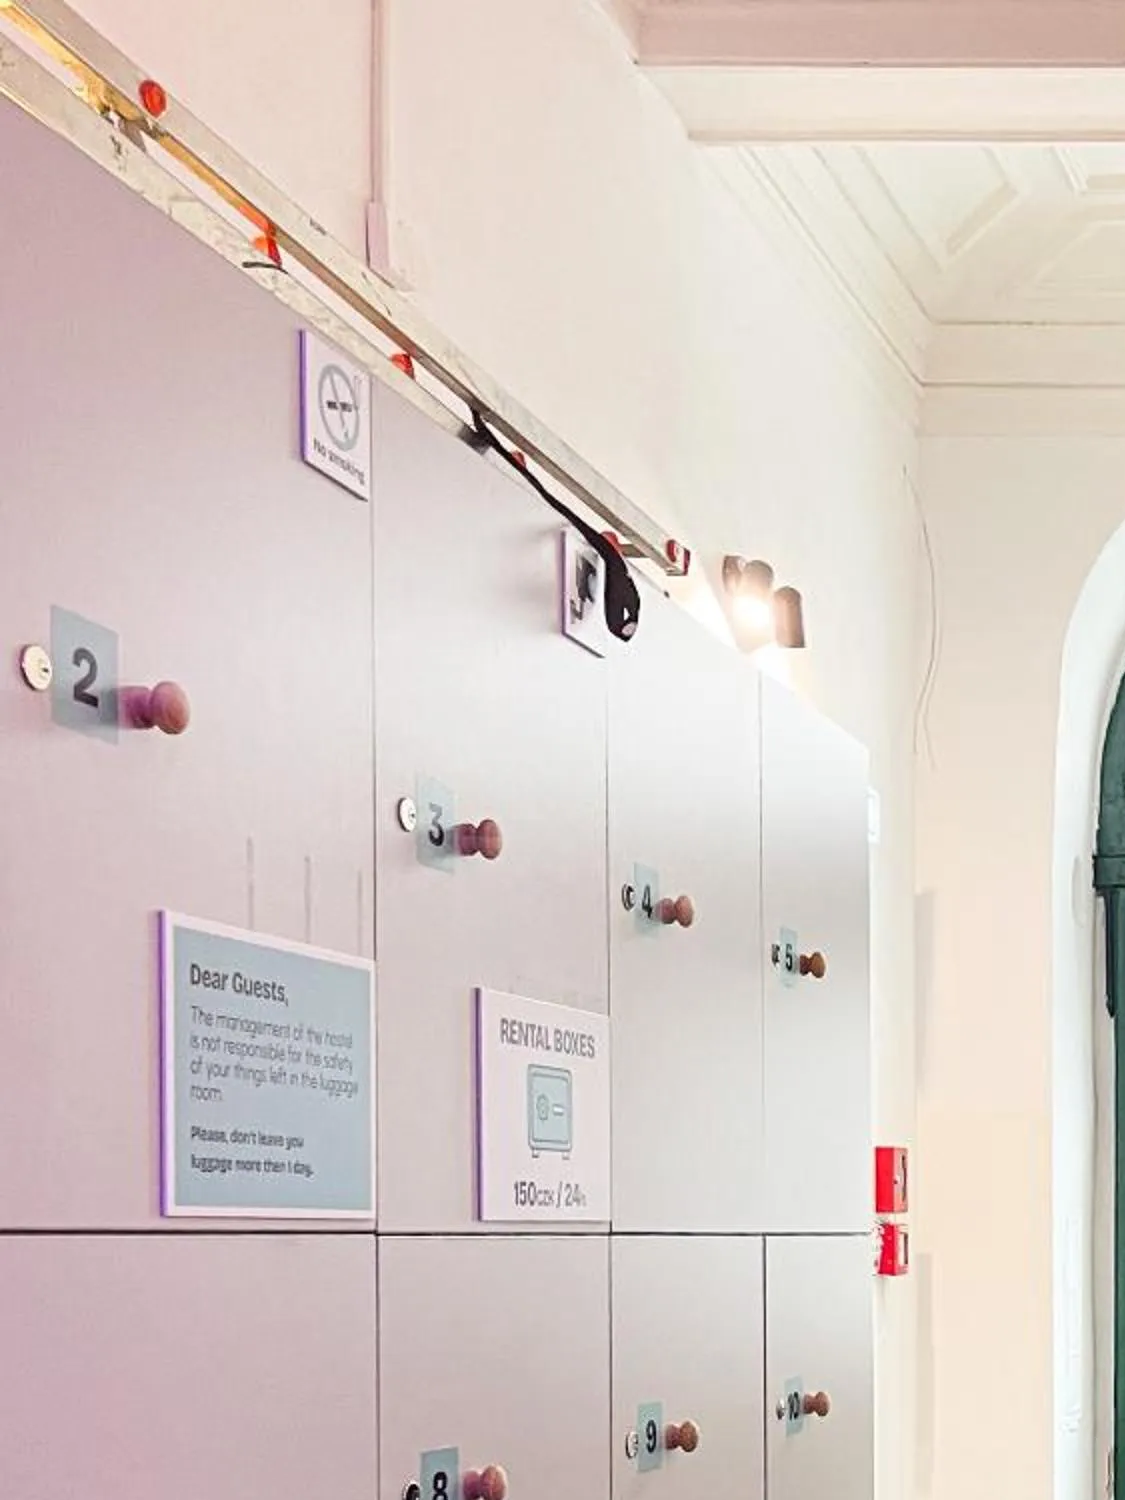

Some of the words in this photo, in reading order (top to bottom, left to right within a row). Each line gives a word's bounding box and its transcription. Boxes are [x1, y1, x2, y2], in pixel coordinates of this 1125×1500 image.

[313, 437, 327, 459] No
[72, 646, 99, 709] 2
[428, 802, 445, 847] 3
[641, 884, 653, 919] 4
[784, 943, 794, 972] 5
[190, 963, 228, 992] Dear
[231, 971, 289, 1007] Guests,
[191, 1005, 214, 1026] The
[215, 1014, 291, 1039] management
[293, 1023, 304, 1041] of
[306, 1027, 323, 1044] the
[500, 1017, 551, 1051] RENTAL
[553, 1028, 596, 1059] BOXES
[190, 1034, 200, 1049] is
[201, 1036, 221, 1052] not
[223, 1039, 286, 1062] responsible
[287, 1045, 302, 1063] for
[305, 1050, 322, 1067] the
[323, 1053, 353, 1075] safety
[190, 1056, 203, 1075] of
[206, 1063, 230, 1081] your
[233, 1062, 268, 1088] things
[269, 1065, 288, 1085] left
[289, 1071, 299, 1087] in
[301, 1070, 318, 1089] the
[320, 1073, 359, 1099] luggage
[191, 1125, 229, 1144] Please,
[229, 1128, 257, 1145] don't
[257, 1130, 285, 1147] leave
[191, 1153, 233, 1174] luggage
[235, 1159, 262, 1173] more
[645, 1419, 657, 1454] 9
